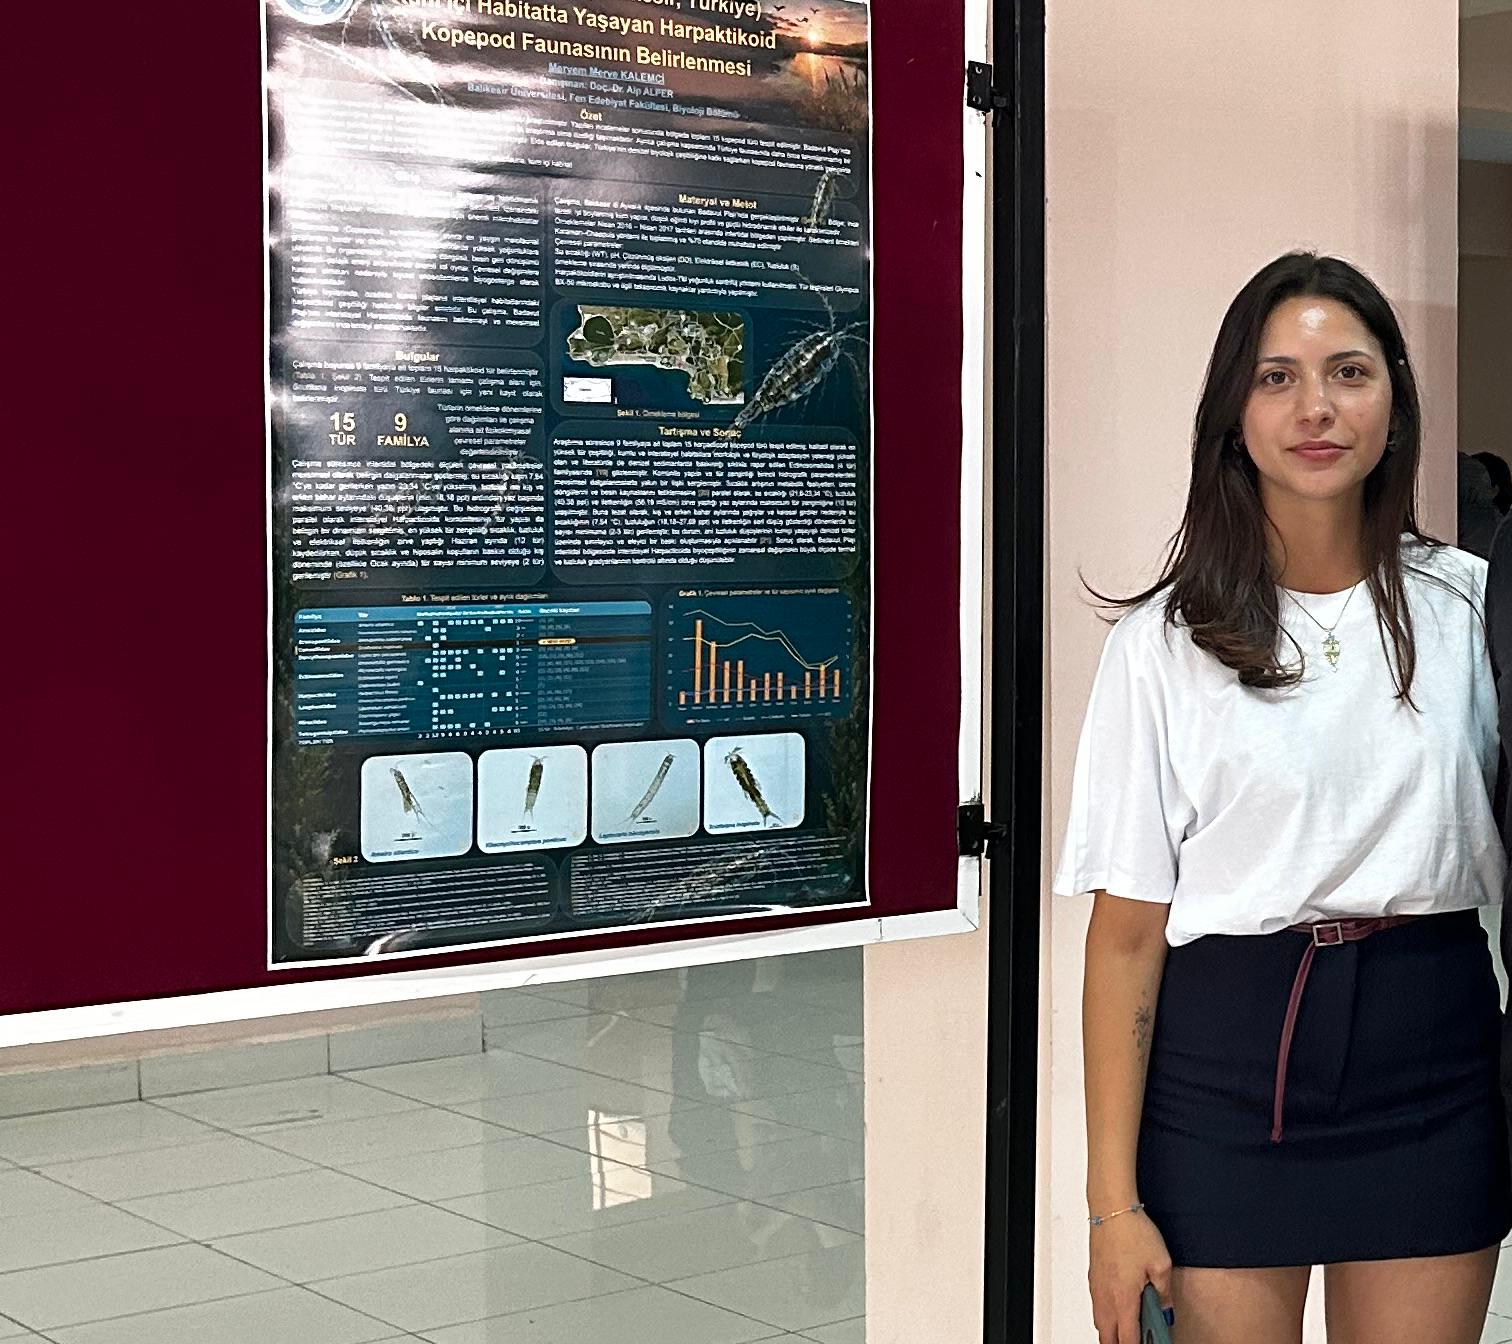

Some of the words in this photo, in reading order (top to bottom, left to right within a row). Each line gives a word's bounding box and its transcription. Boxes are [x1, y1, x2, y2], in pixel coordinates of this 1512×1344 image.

[573, 7, 654, 36] Yaşayan
[660, 18, 776, 50] Harpaktikoid
[421, 21, 515, 50] Kopepod
[522, 32, 631, 62] Faunasının
[636, 46, 752, 77] Belirlenmesi
[588, 96, 627, 108] Edebiyat
[579, 108, 603, 122] Özet
[678, 194, 718, 206] Materyal
[719, 199, 731, 207] ve
[731, 198, 758, 209] Metot
[394, 350, 440, 364] Bulgular
[329, 411, 356, 432] 15
[394, 412, 408, 432] 9
[328, 431, 356, 446] TÜR
[377, 433, 430, 447] FAMİLYA
[658, 426, 698, 438] Tartışma
[700, 428, 711, 437] ve
[712, 427, 742, 439] Sonuç
